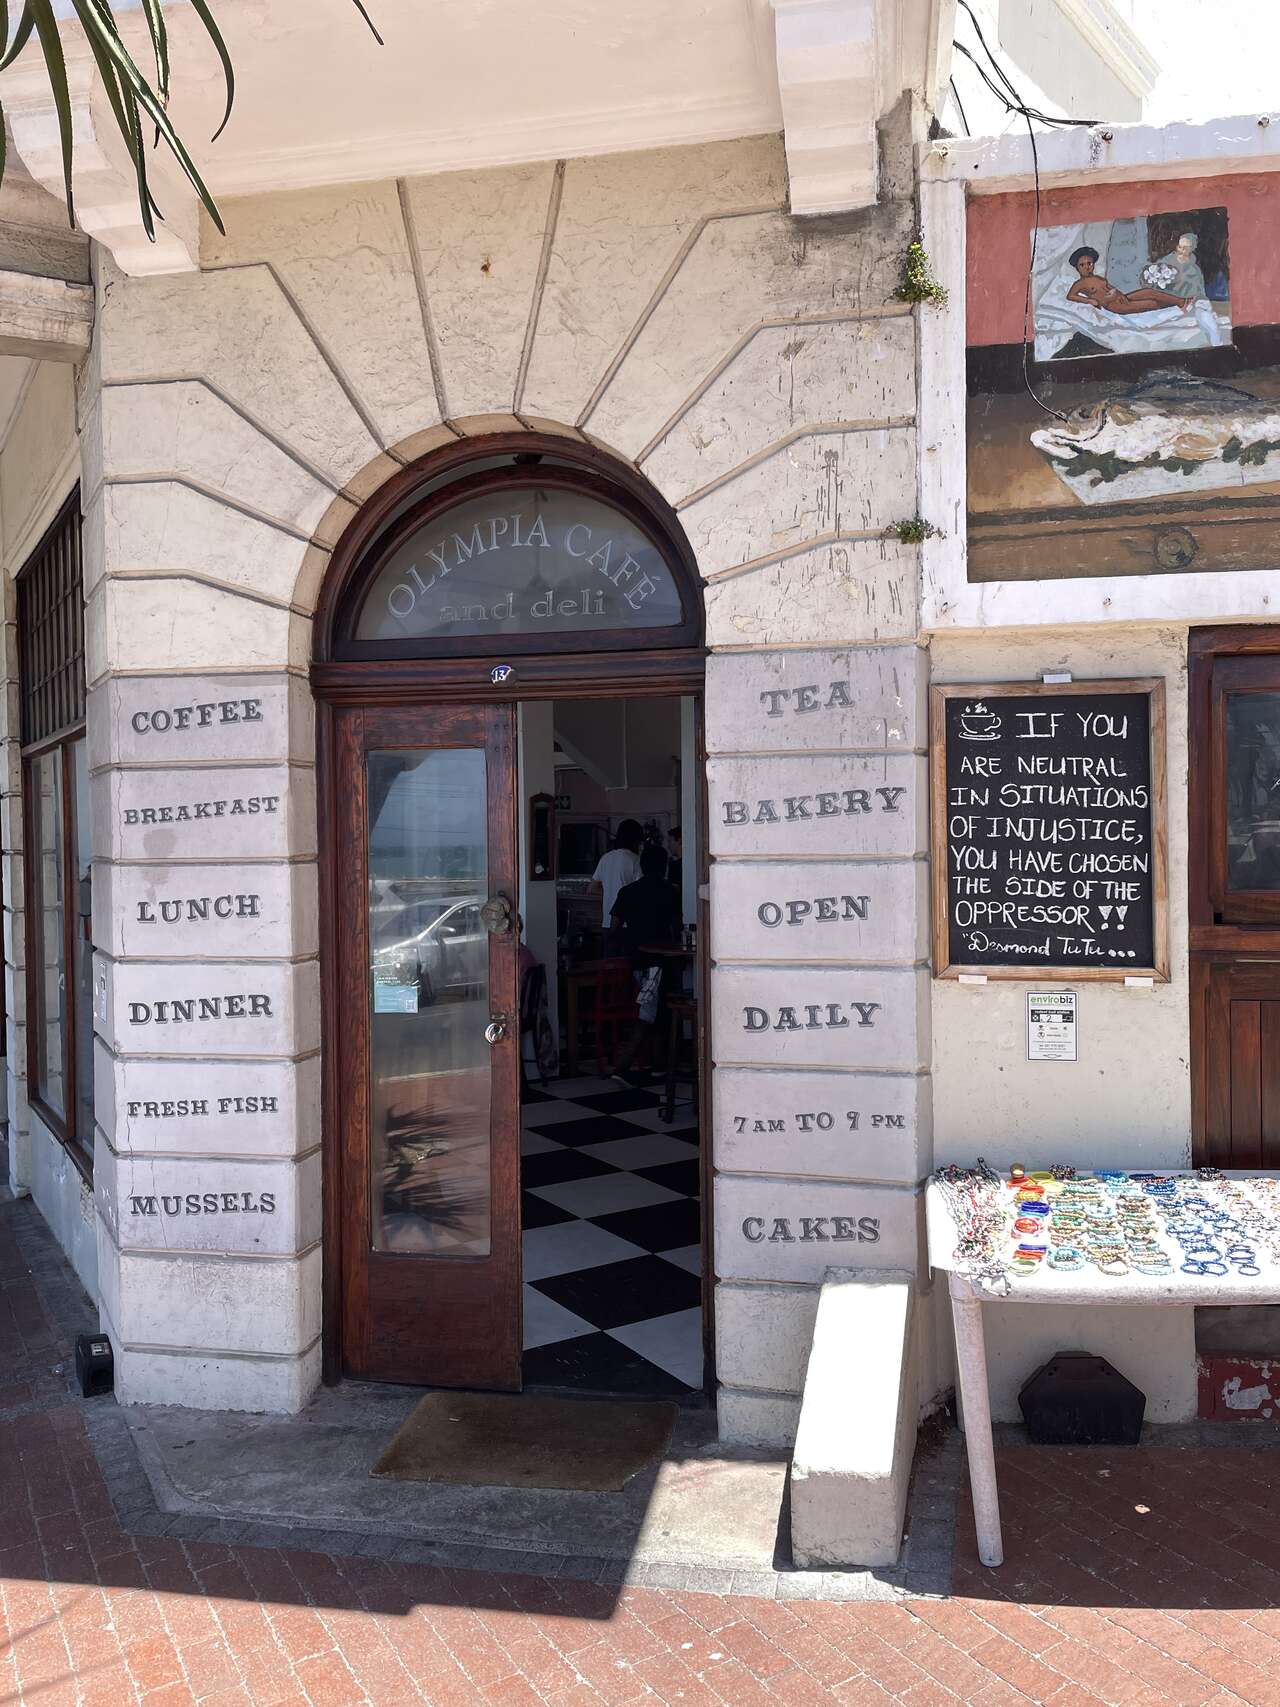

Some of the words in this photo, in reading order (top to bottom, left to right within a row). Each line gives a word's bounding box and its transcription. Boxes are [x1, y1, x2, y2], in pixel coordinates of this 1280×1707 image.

[387, 513, 551, 618] OLYMPIA
[440, 592, 515, 622] and
[531, 588, 607, 617] deli
[760, 680, 853, 717] TEA
[131, 699, 263, 734] COFFEE
[1016, 713, 1064, 738] IF
[1076, 712, 1128, 739] YOU
[960, 756, 1002, 777] ARE
[1017, 755, 1127, 785] NEUTRAL
[124, 796, 279, 825] BREAKFAST
[722, 787, 907, 827] BAKERY
[951, 787, 989, 806] IN
[999, 783, 1148, 809] SITUATIONS
[950, 815, 982, 839] OF
[951, 845, 997, 871] YOU
[1009, 849, 1063, 873] HAVE
[1069, 853, 1148, 874] CHOSEN
[953, 876, 991, 895] THE
[1005, 876, 1066, 898] SIDE
[1073, 880, 1099, 900] OF
[1100, 881, 1141, 901] THE
[136, 894, 260, 923] LUNCH
[757, 895, 872, 928] OPEN
[128, 994, 273, 1026] DINNER
[1031, 995, 1073, 1004] envirobiz
[743, 1002, 882, 1033] DAILY
[127, 1100, 208, 1118] FRESH
[217, 1096, 278, 1115] FISH
[795, 1111, 836, 1133] TO
[871, 1114, 906, 1130] PM
[130, 1192, 276, 1217] MUSSELS
[741, 1216, 880, 1243] CAKES
